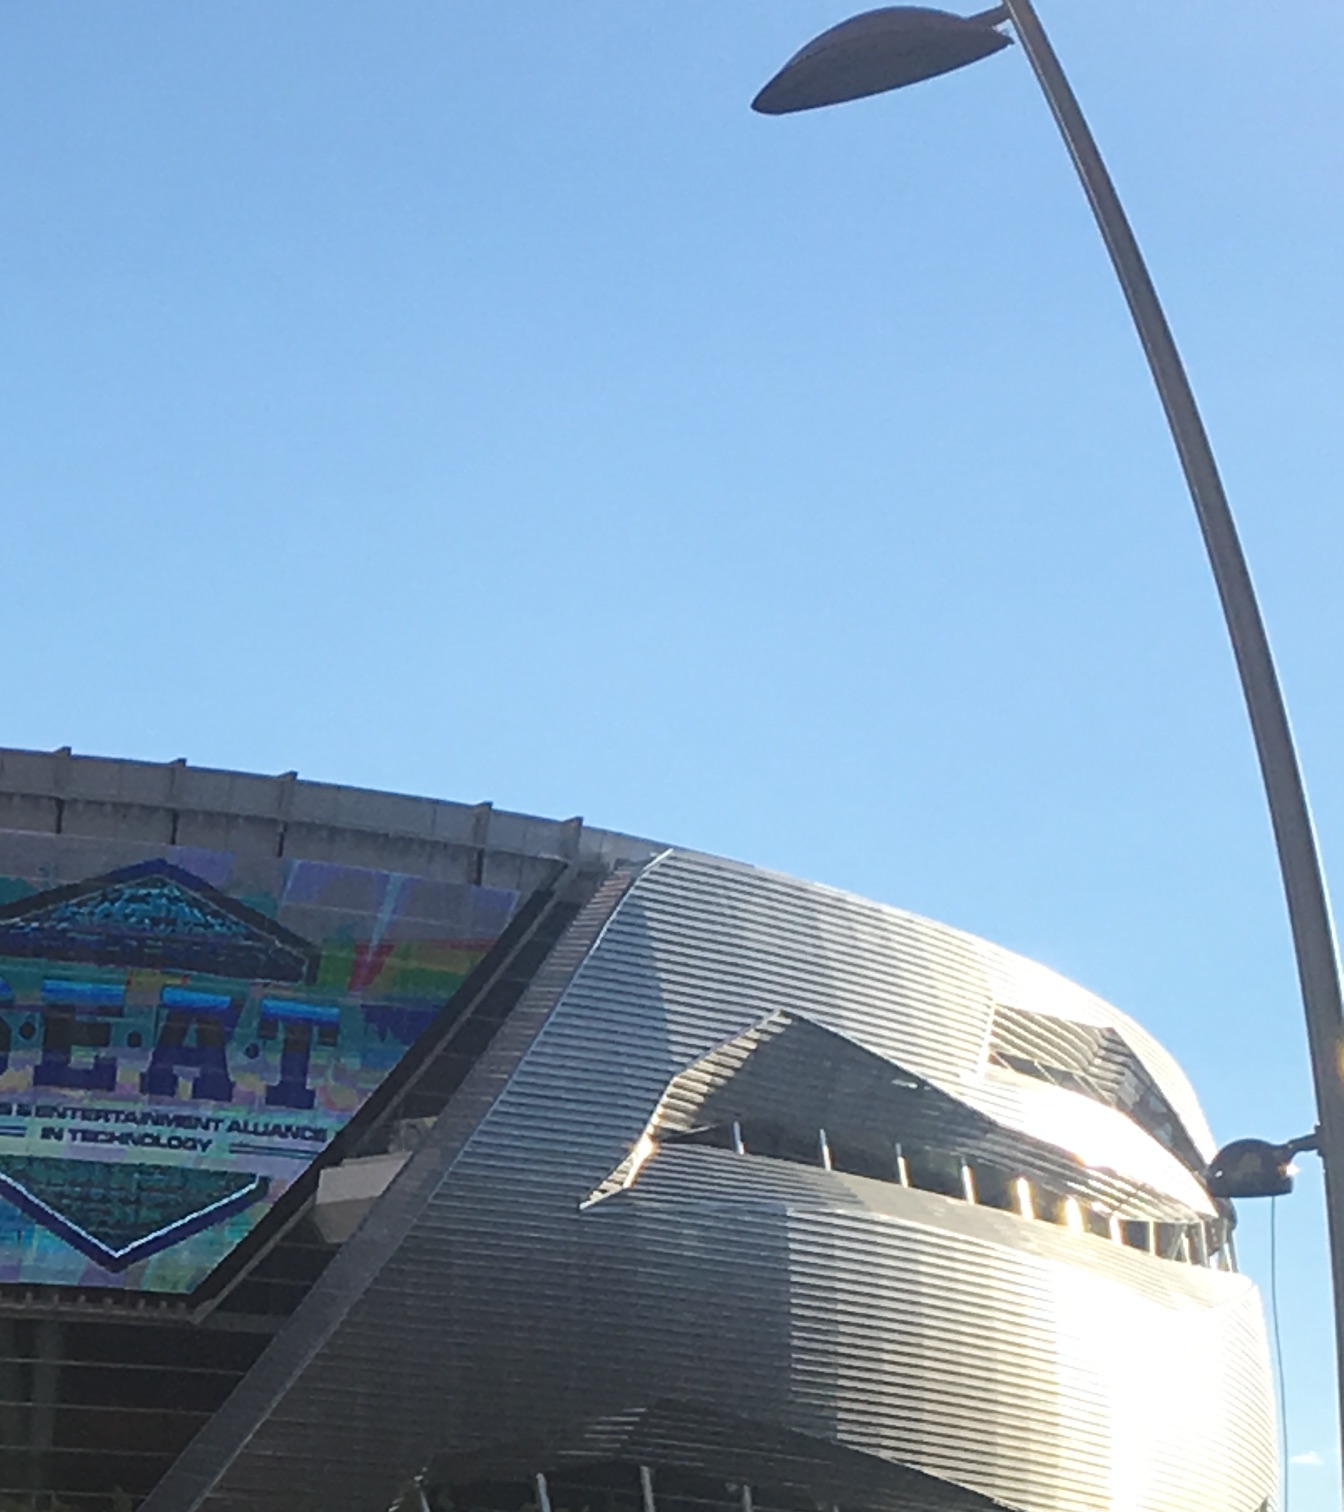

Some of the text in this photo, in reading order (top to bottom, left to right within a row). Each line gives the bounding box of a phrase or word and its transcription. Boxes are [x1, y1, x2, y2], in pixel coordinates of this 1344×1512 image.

[16, 1103, 31, 1118] &
[34, 1103, 224, 1132] ENTERTAINMENT
[226, 1117, 328, 1143] ALLIANCE
[40, 1126, 213, 1153] IN TECHNOLOGY
